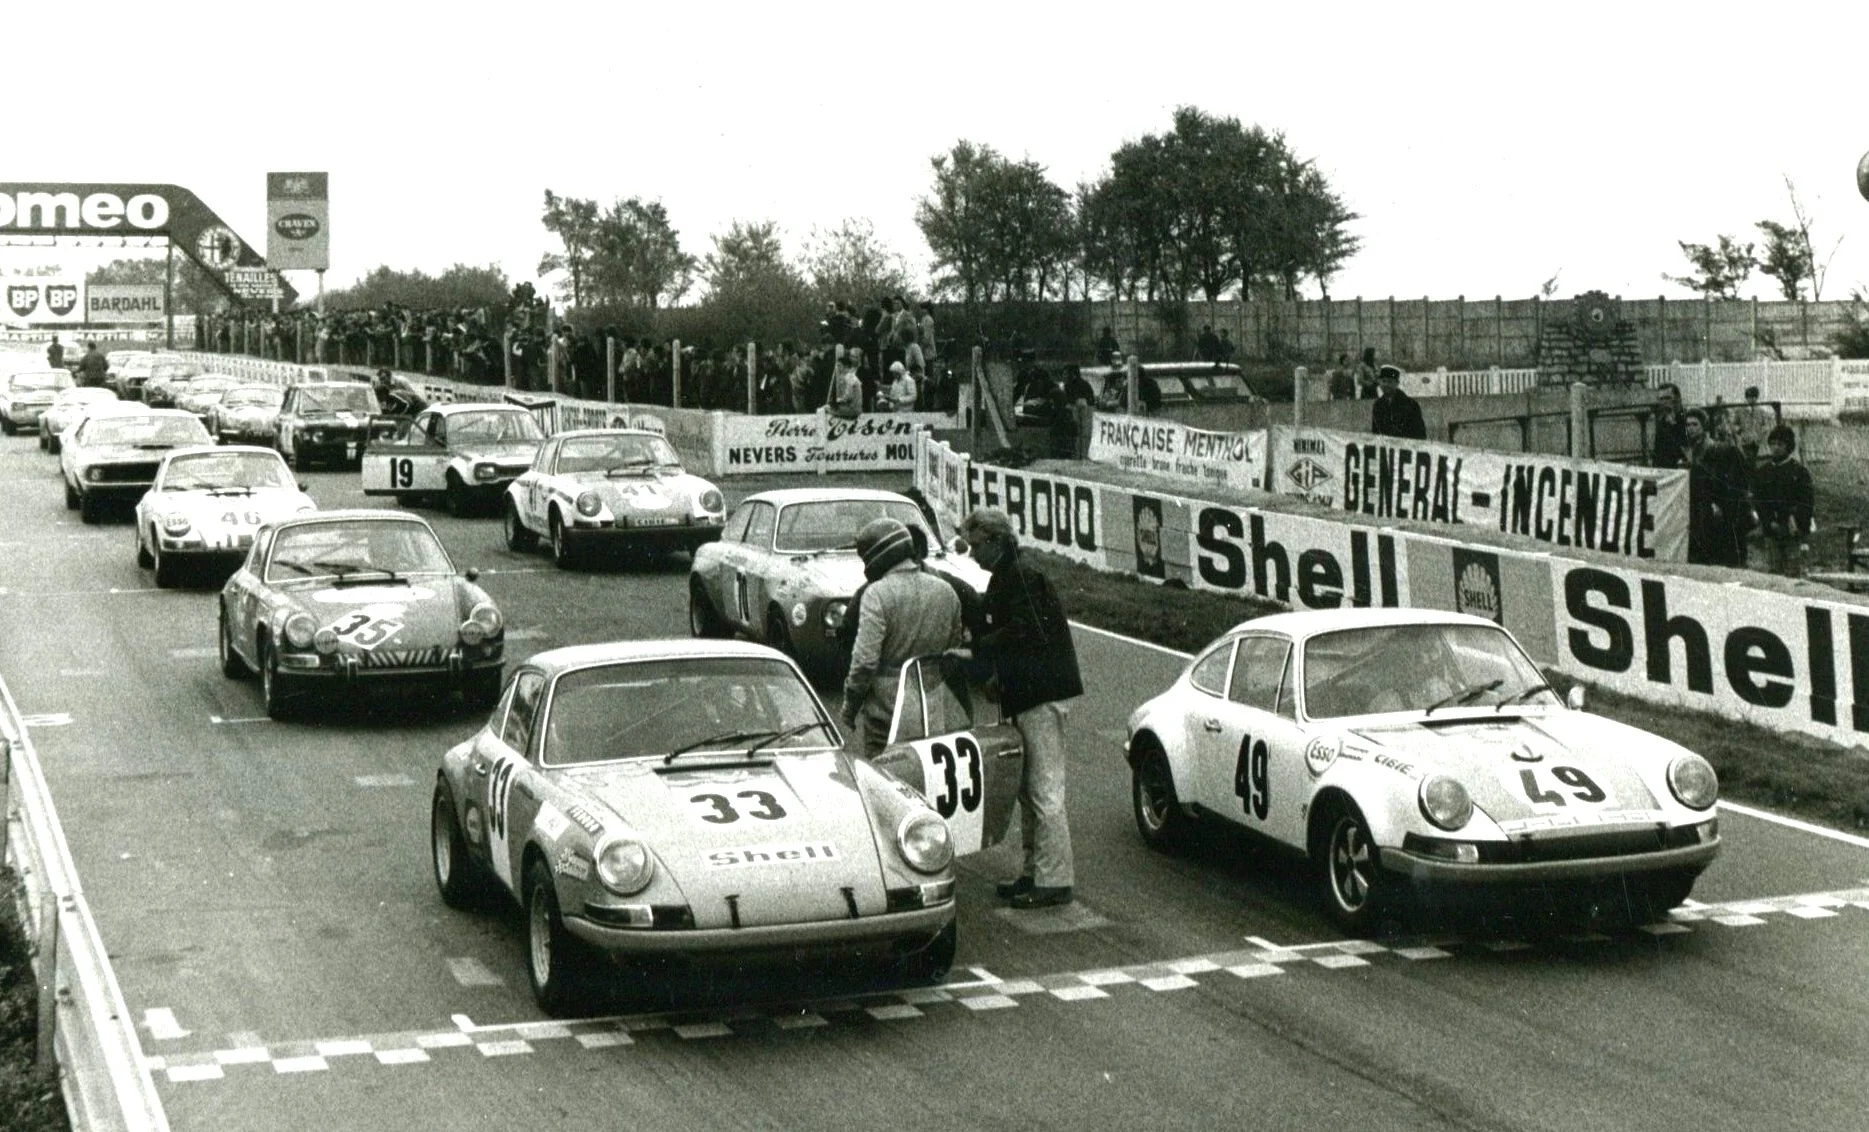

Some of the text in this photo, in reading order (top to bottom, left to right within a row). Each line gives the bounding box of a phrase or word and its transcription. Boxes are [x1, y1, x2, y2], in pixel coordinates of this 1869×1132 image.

[12, 289, 38, 308] BP
[50, 289, 77, 308] BP
[90, 297, 161, 314] BARDAHL
[728, 445, 797, 465] NEVERS
[1100, 421, 1254, 464] FRANÇAISE MENTHOL
[390, 457, 414, 488] 19
[1344, 443, 1464, 524] GENERAL
[1500, 463, 1658, 559] INCENDIE
[1196, 507, 1397, 609] Shell
[1462, 588, 1495, 611] SHELL
[333, 614, 399, 646] 35
[1563, 566, 1869, 732] Shell
[1309, 740, 1415, 776] ESSO CIBIE
[931, 736, 983, 820] 33
[1235, 733, 1269, 821] 49
[1519, 765, 1607, 807] 49
[691, 790, 787, 824] 33
[708, 845, 834, 867] Shell
